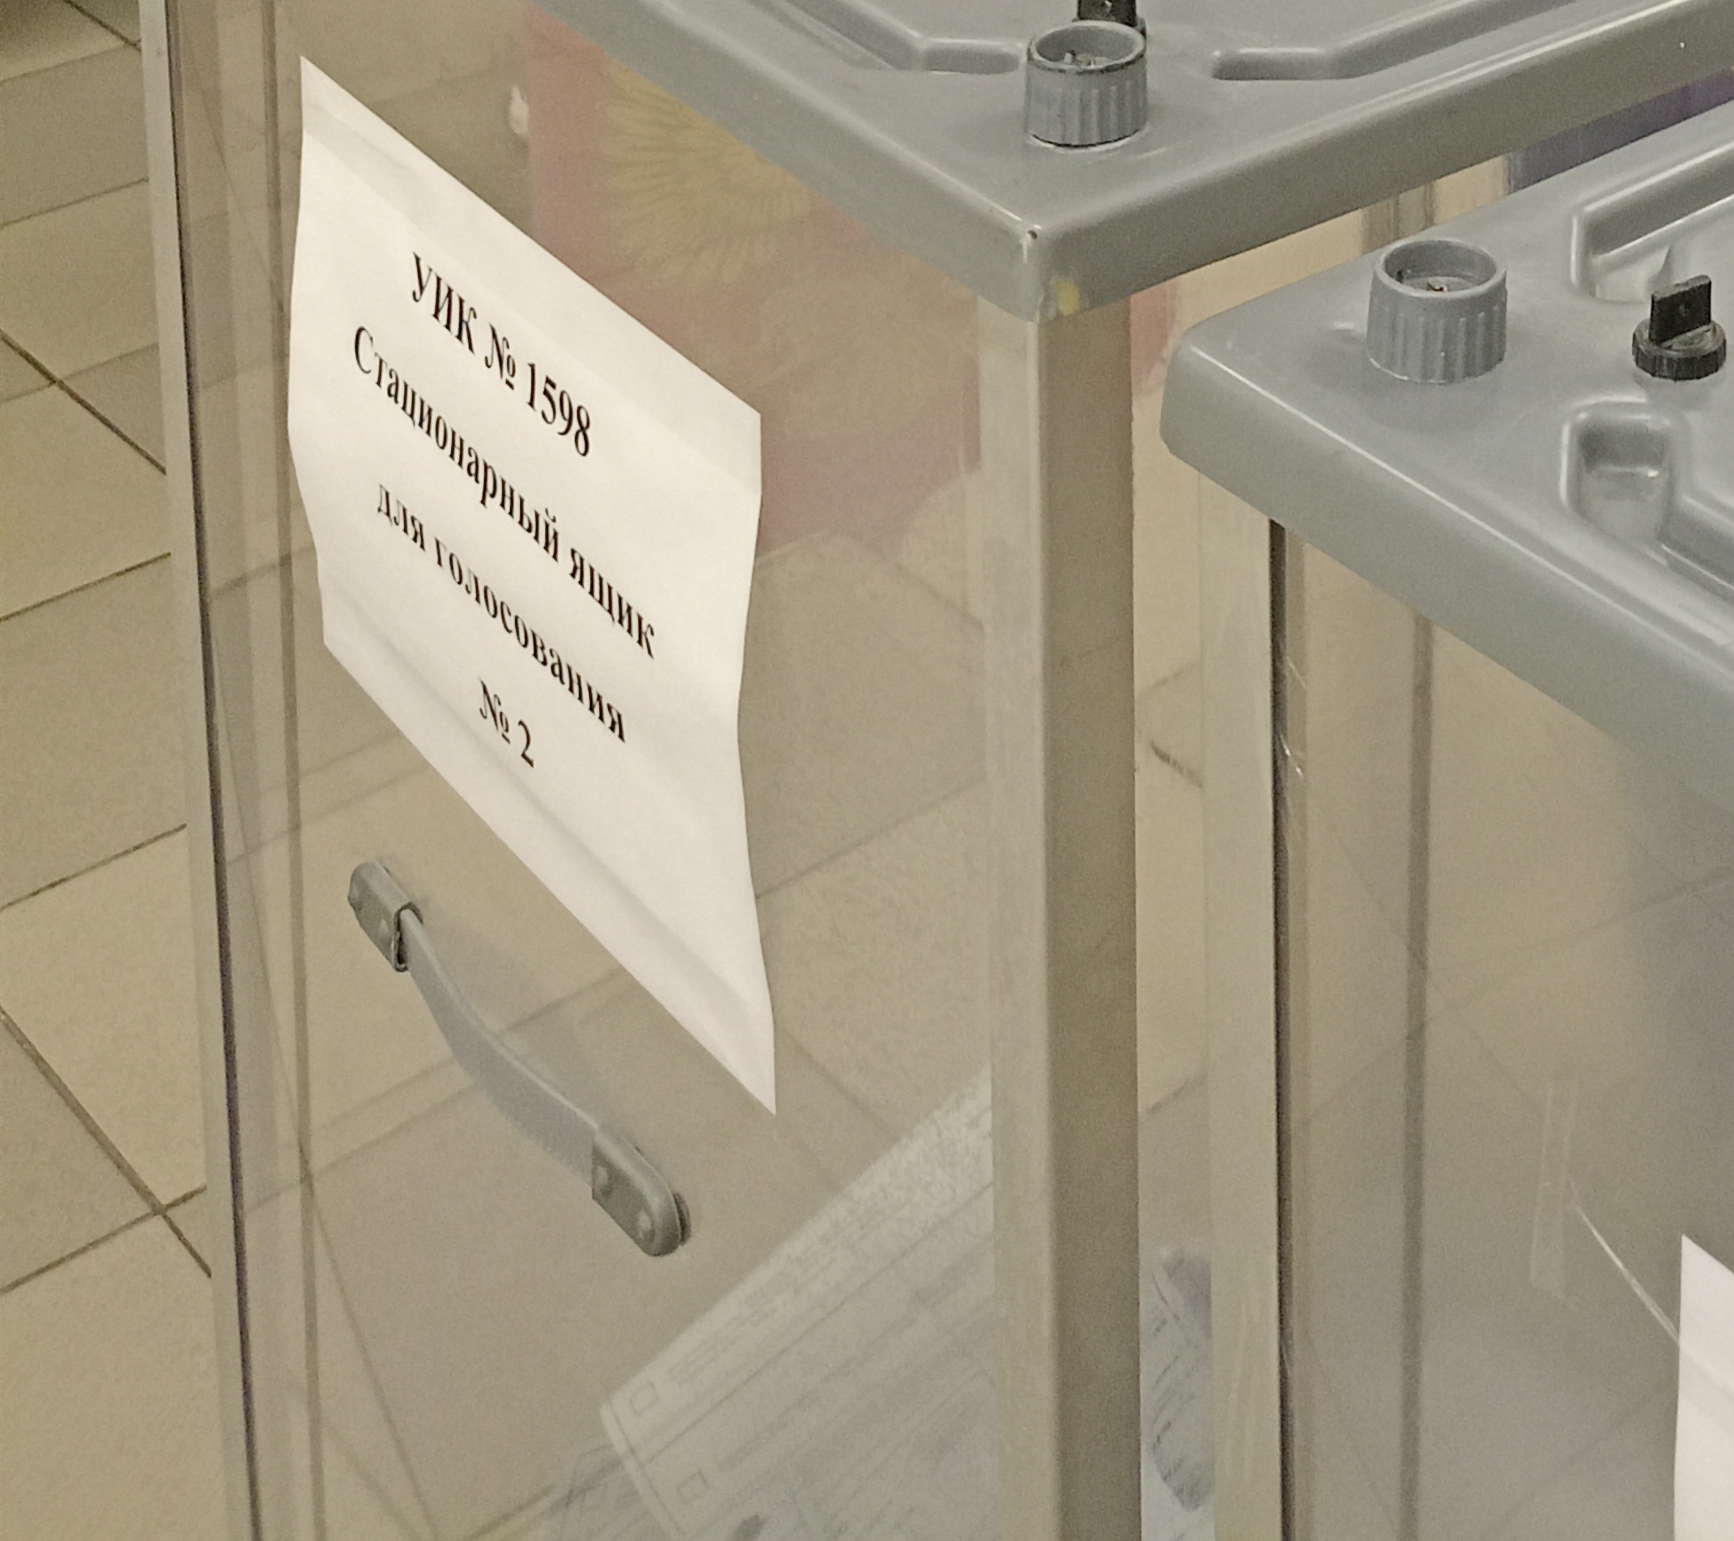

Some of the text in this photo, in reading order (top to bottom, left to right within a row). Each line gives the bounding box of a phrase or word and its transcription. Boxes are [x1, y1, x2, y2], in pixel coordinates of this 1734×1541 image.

[412, 251, 591, 457] УИК № 1598
[354, 326, 655, 659] Стационарный ящик
[377, 483, 626, 743] для голосования
[479, 679, 534, 769] № 2
